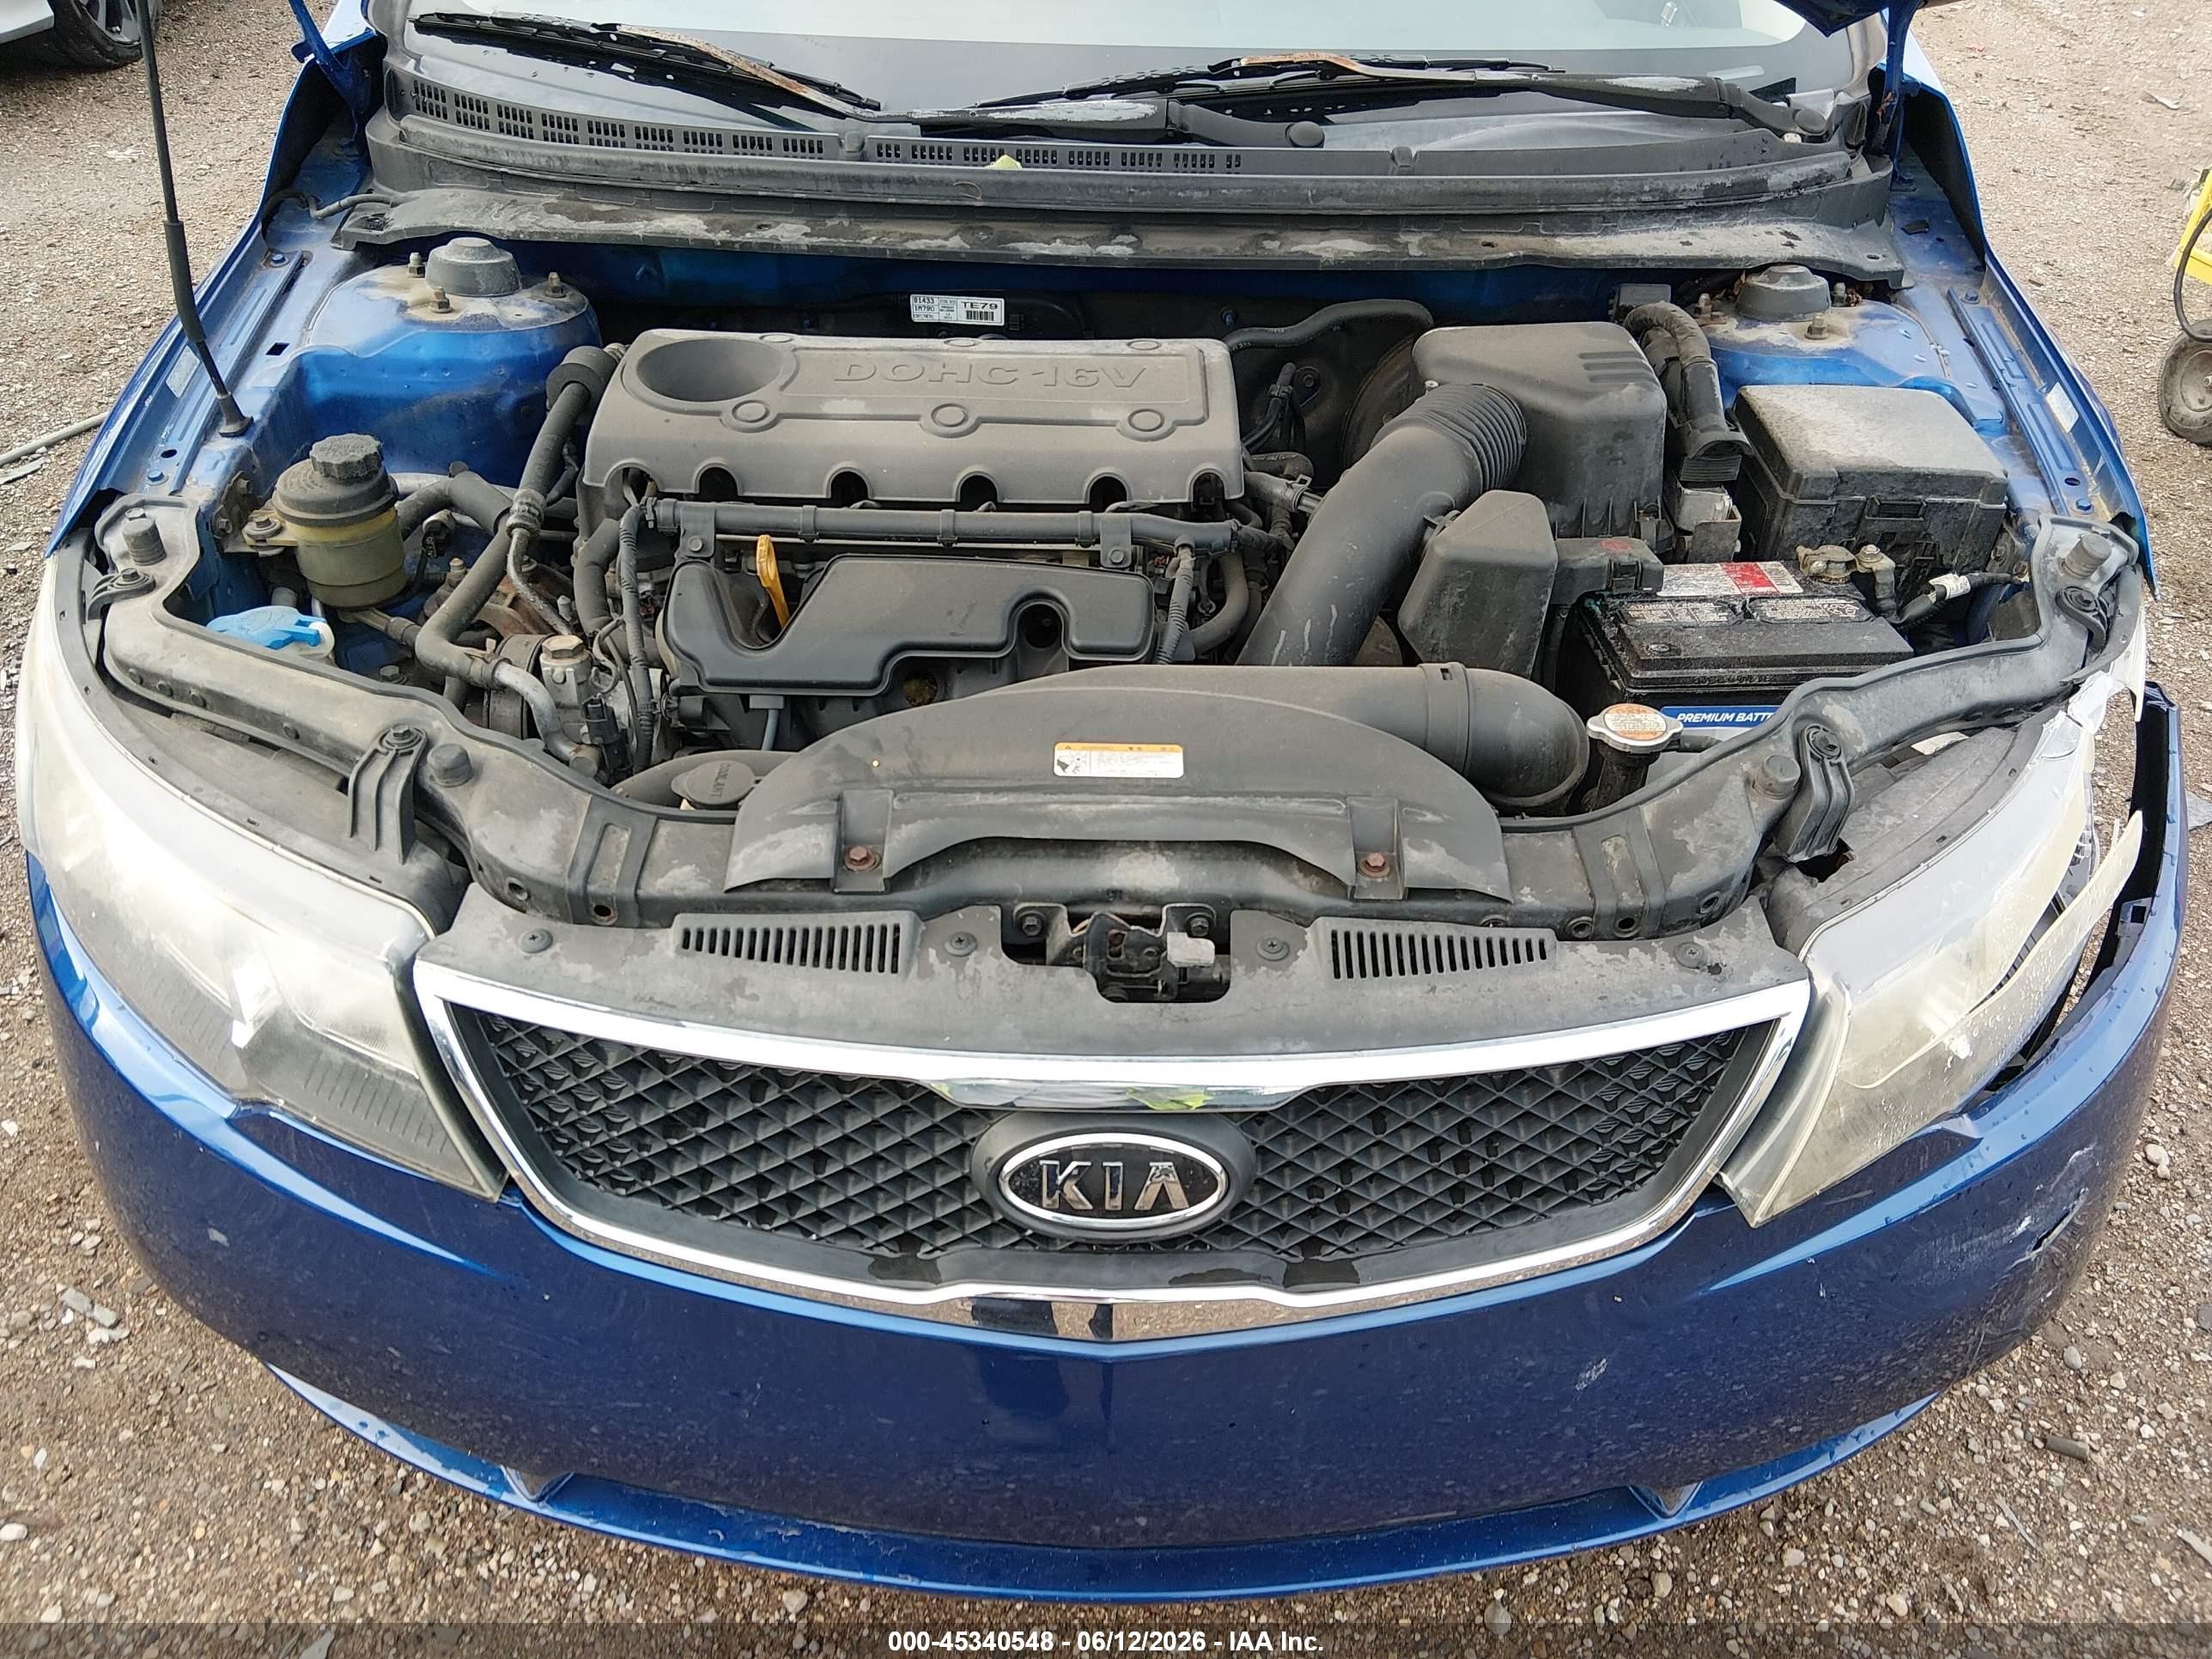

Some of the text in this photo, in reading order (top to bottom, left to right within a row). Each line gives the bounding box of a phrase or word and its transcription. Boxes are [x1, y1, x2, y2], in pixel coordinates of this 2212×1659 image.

[962, 301, 998, 310] TE79
[833, 362, 1018, 386] DOHC
[1677, 713, 1735, 723] PREMIUM
[1039, 1159, 1189, 1211] KIA
